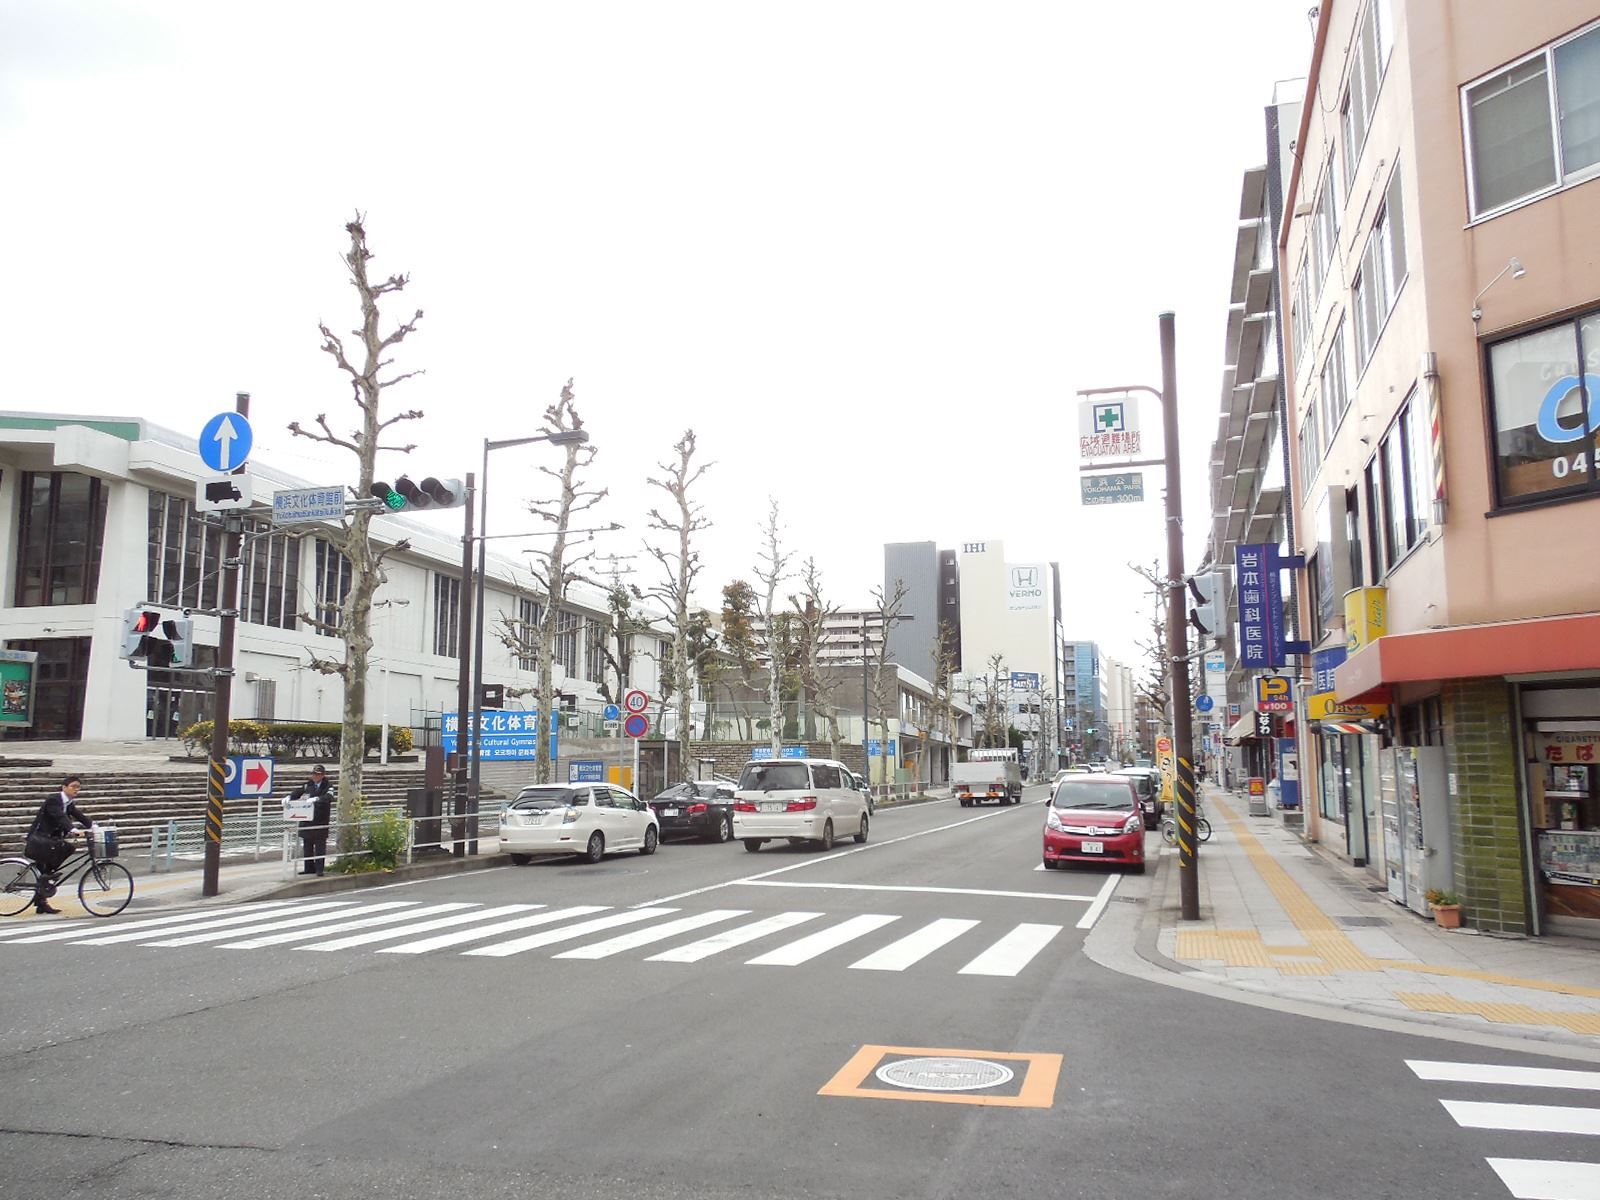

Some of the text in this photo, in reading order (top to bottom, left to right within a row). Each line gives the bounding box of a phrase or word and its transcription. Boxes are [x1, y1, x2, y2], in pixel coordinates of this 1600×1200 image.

[1080, 431, 1141, 448] 広域避難場所
[1081, 442, 1142, 457] EVACUATION AREA
[1083, 485, 1121, 493] YOKOHAMA
[275, 491, 342, 509] 横浜文化体育館前
[1117, 494, 1141, 503] 300m
[963, 543, 986, 553] IHI
[1009, 589, 1042, 598] VERMO
[1242, 553, 1263, 659] 岩本歯科医院
[1260, 678, 1288, 701] P
[630, 696, 643, 707] 40
[445, 714, 553, 732] 横文化体育
[483, 738, 509, 746] Cultural
[511, 738, 536, 747] Gymnas
[1556, 735, 1600, 743] CIGARETT
